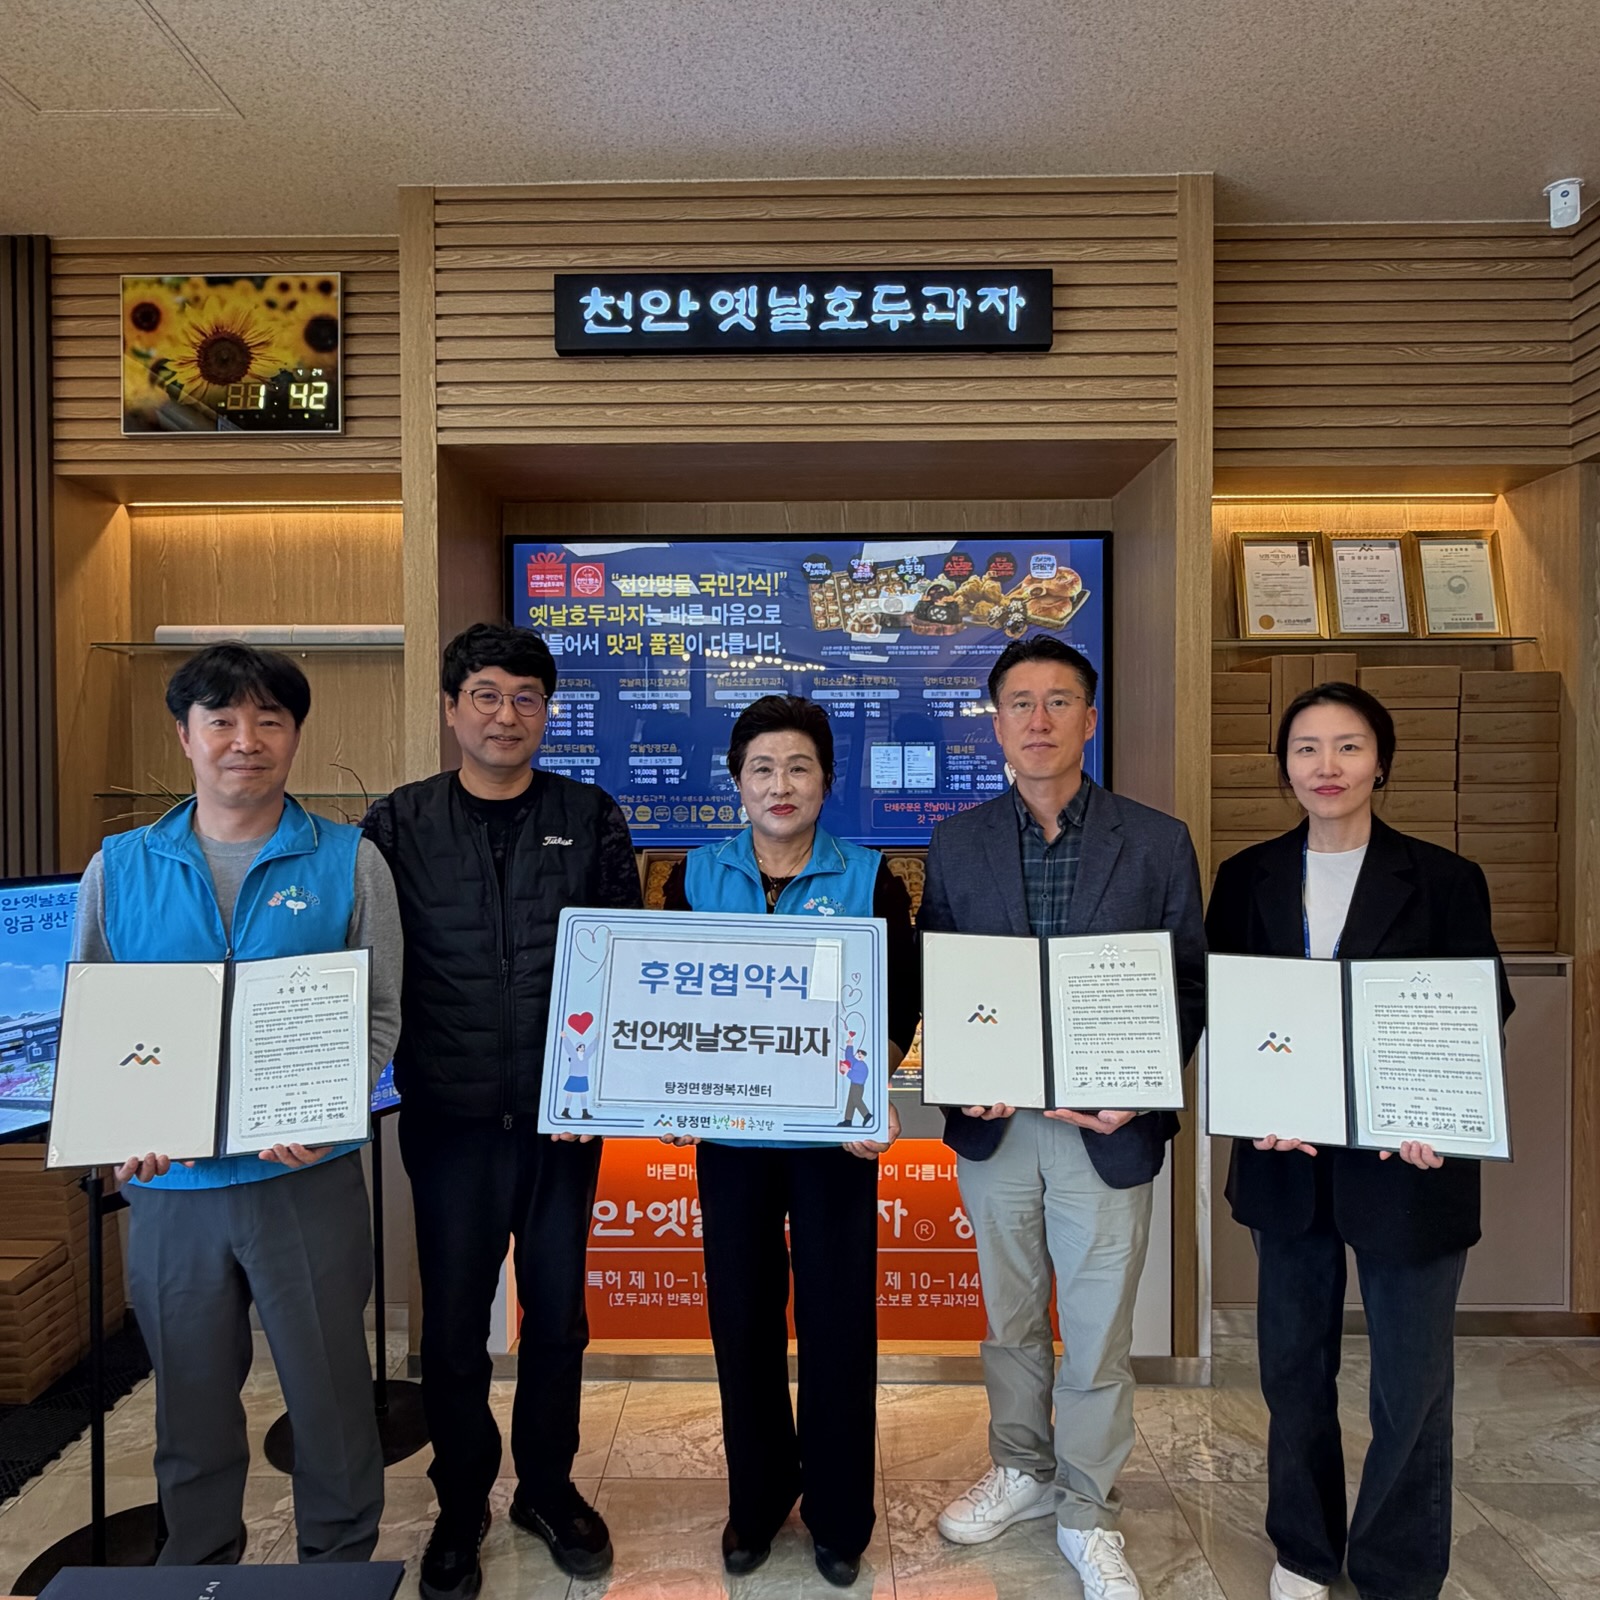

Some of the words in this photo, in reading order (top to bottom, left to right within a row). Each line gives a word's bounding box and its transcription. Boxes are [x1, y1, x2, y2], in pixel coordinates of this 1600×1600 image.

[529, 604, 663, 627] 옛날호두과자는
[671, 603, 704, 626] 바른
[711, 603, 782, 626] 마음으로
[541, 633, 599, 656] 들어서
[606, 633, 643, 656] 맛과
[649, 632, 703, 656] 품질이
[711, 632, 787, 655] 다릅니다.
[4, 914, 35, 934] 앙금
[39, 910, 68, 930] 생산
[638, 960, 809, 1000] 후원협약식
[611, 1019, 831, 1057] 천안옛날호두과자
[664, 1081, 772, 1097] 탕정면행정복지센터
[647, 1164, 697, 1180] 바른마
[587, 1270, 621, 1290] 특허
[629, 1270, 645, 1290] 제
[885, 1271, 901, 1290] 제
[609, 1292, 662, 1307] (호두과자
[667, 1292, 703, 1306] 반죽의
[876, 1294, 913, 1307] 소보로
[918, 1293, 979, 1307] 호두과자의
